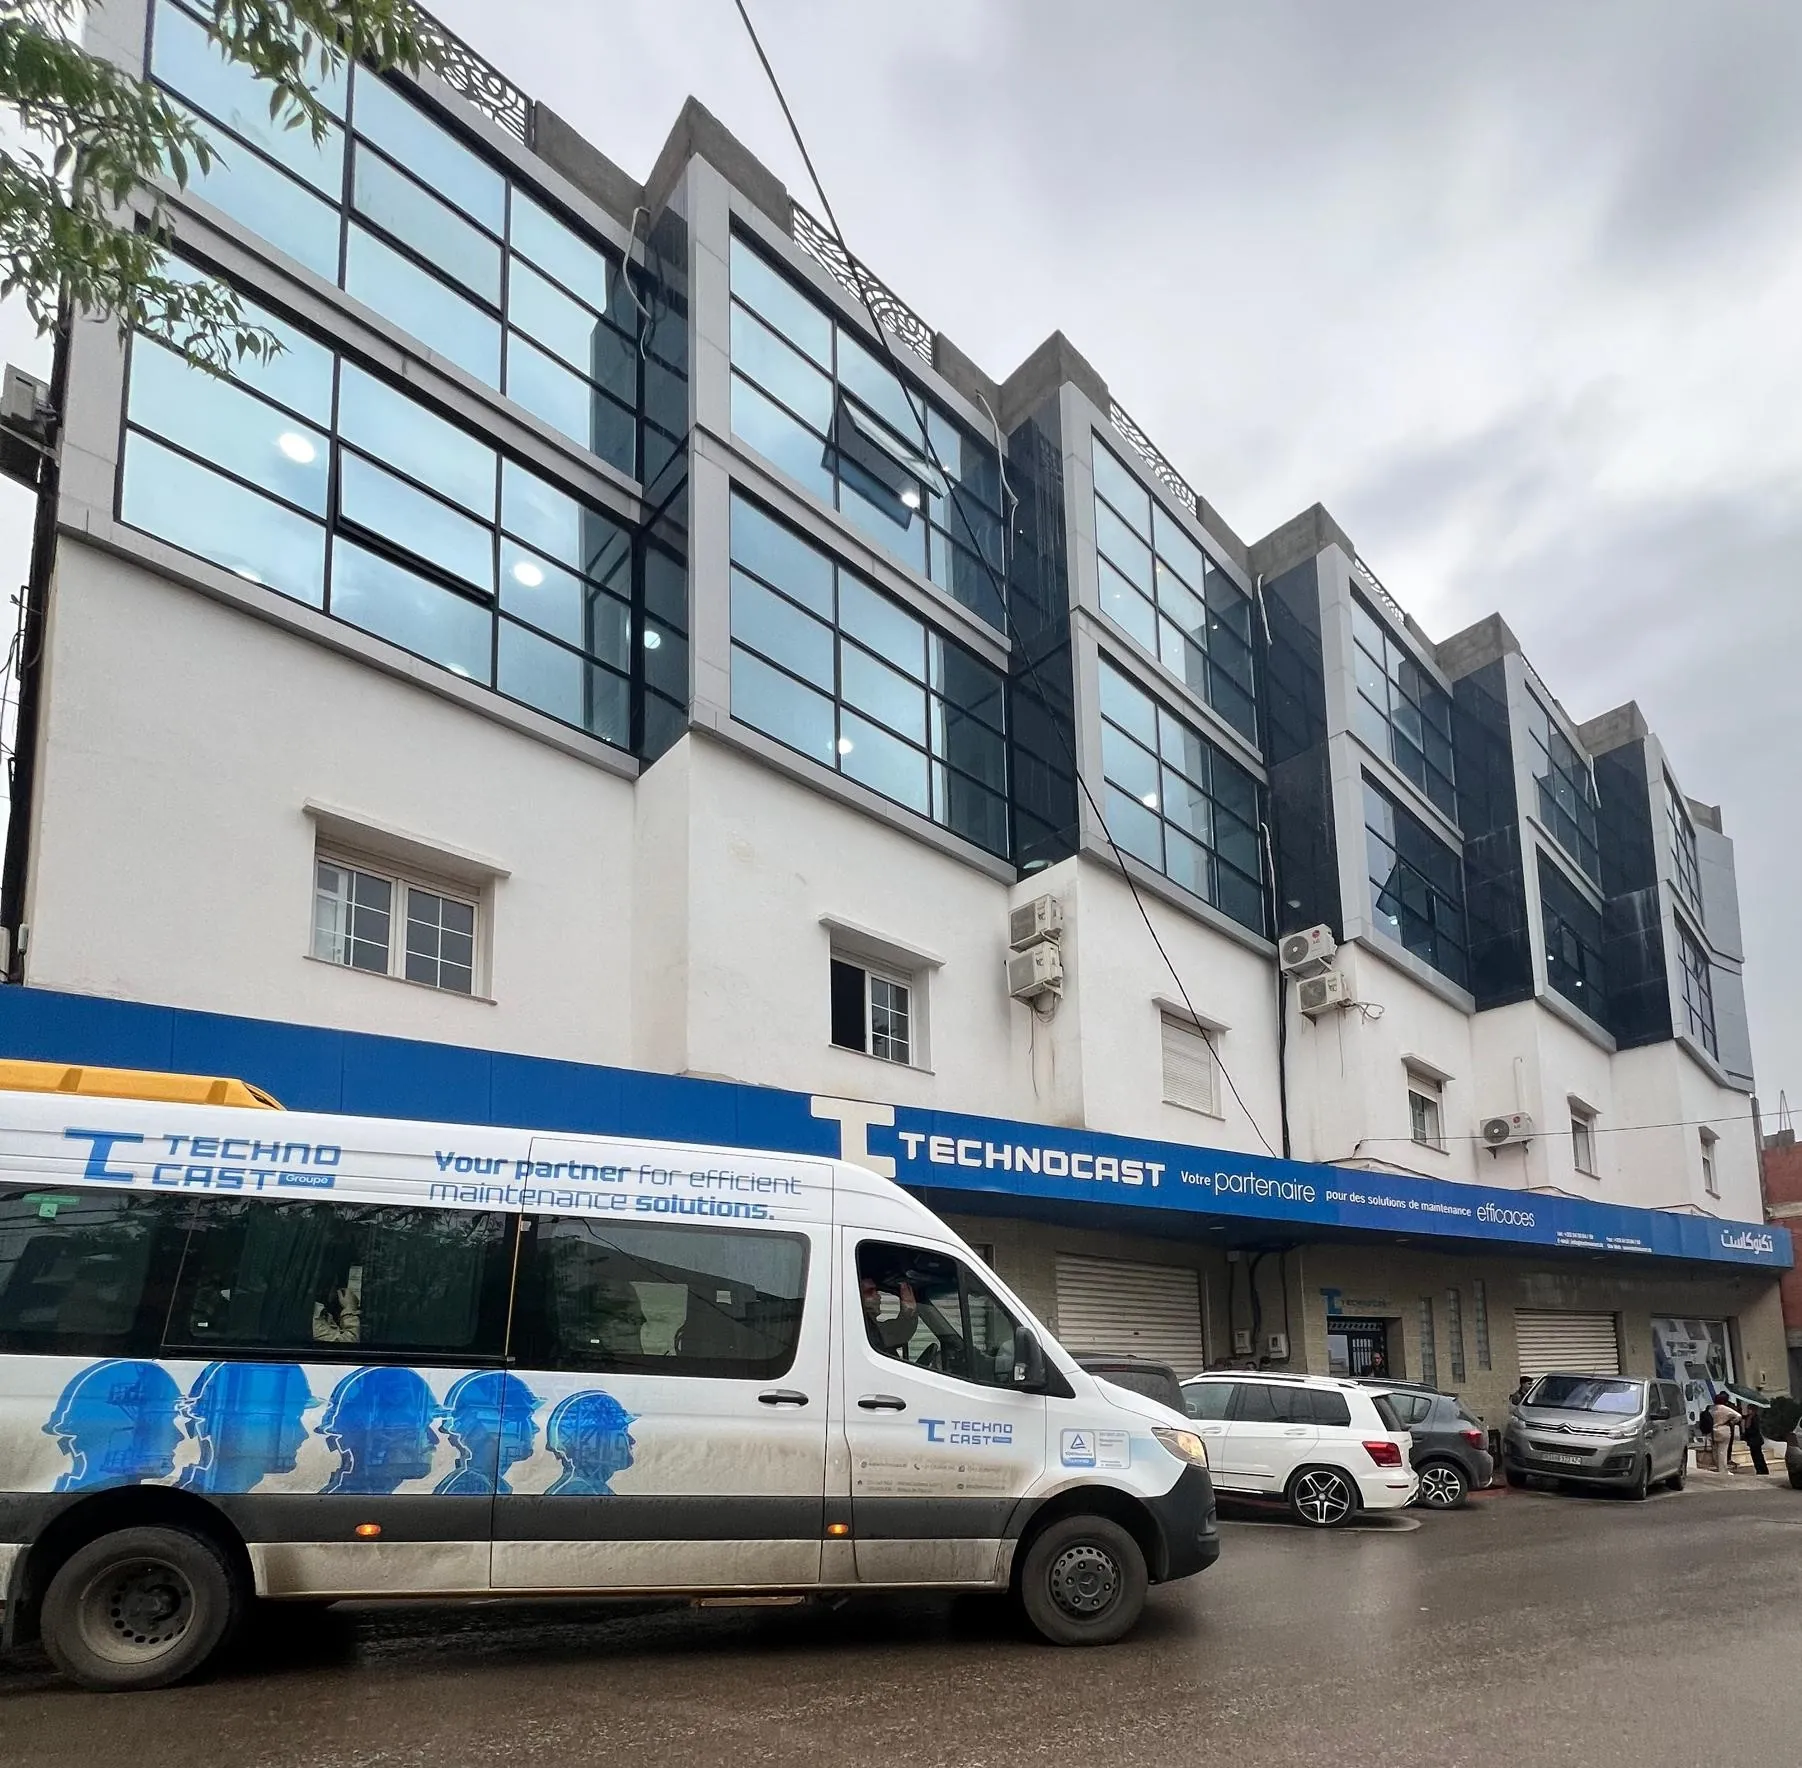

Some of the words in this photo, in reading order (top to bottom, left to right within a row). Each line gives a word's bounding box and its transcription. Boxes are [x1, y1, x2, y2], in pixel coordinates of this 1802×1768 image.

[162, 1133, 342, 1167] TECHNO
[898, 1131, 1166, 1187] TECHNOCAST
[152, 1163, 277, 1191] CAST
[285, 1173, 329, 1185] Groupe
[435, 1150, 508, 1174] Your
[515, 1159, 633, 1183] partner
[638, 1164, 682, 1187] for
[688, 1169, 803, 1195] efficient
[430, 1182, 627, 1211] maintenance
[635, 1194, 776, 1220] solutions.
[1180, 1170, 1211, 1187] Votre
[1214, 1170, 1316, 1203] partenaire
[1325, 1190, 1348, 1203] pour
[1349, 1191, 1366, 1205] des
[1367, 1195, 1407, 1209] solutions
[1408, 1199, 1420, 1210] de
[1420, 1201, 1472, 1217] maintenance
[1476, 1203, 1536, 1228] efficaces
[1720, 1229, 1774, 1255] تكنوكاست
[950, 1434, 991, 1445] CAST
[951, 1420, 1013, 1434] TECHNO
